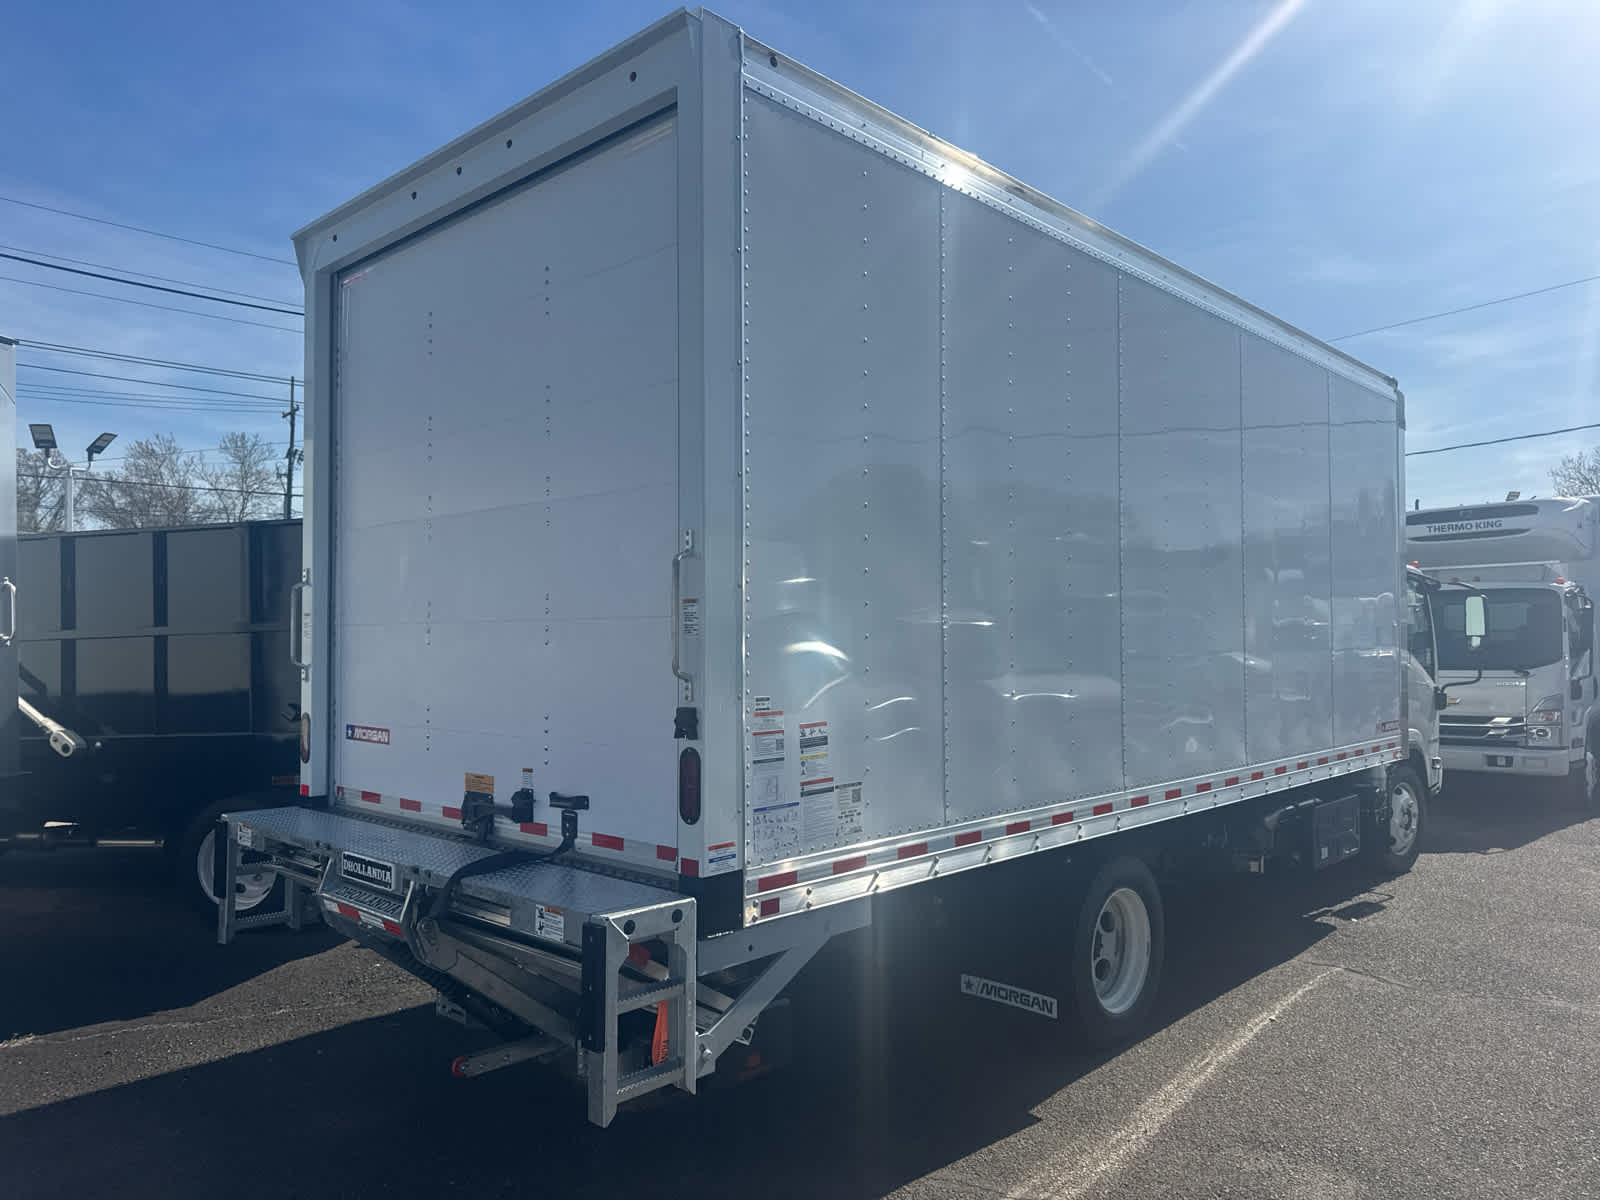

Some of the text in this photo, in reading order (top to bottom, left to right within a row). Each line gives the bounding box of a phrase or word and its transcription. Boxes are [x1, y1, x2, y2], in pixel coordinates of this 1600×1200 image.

[1426, 519, 1503, 533] THERMO KING
[353, 727, 389, 743] MORGAN
[343, 859, 392, 884] DHOLLANDIA
[980, 982, 1054, 1016] MORGAN
